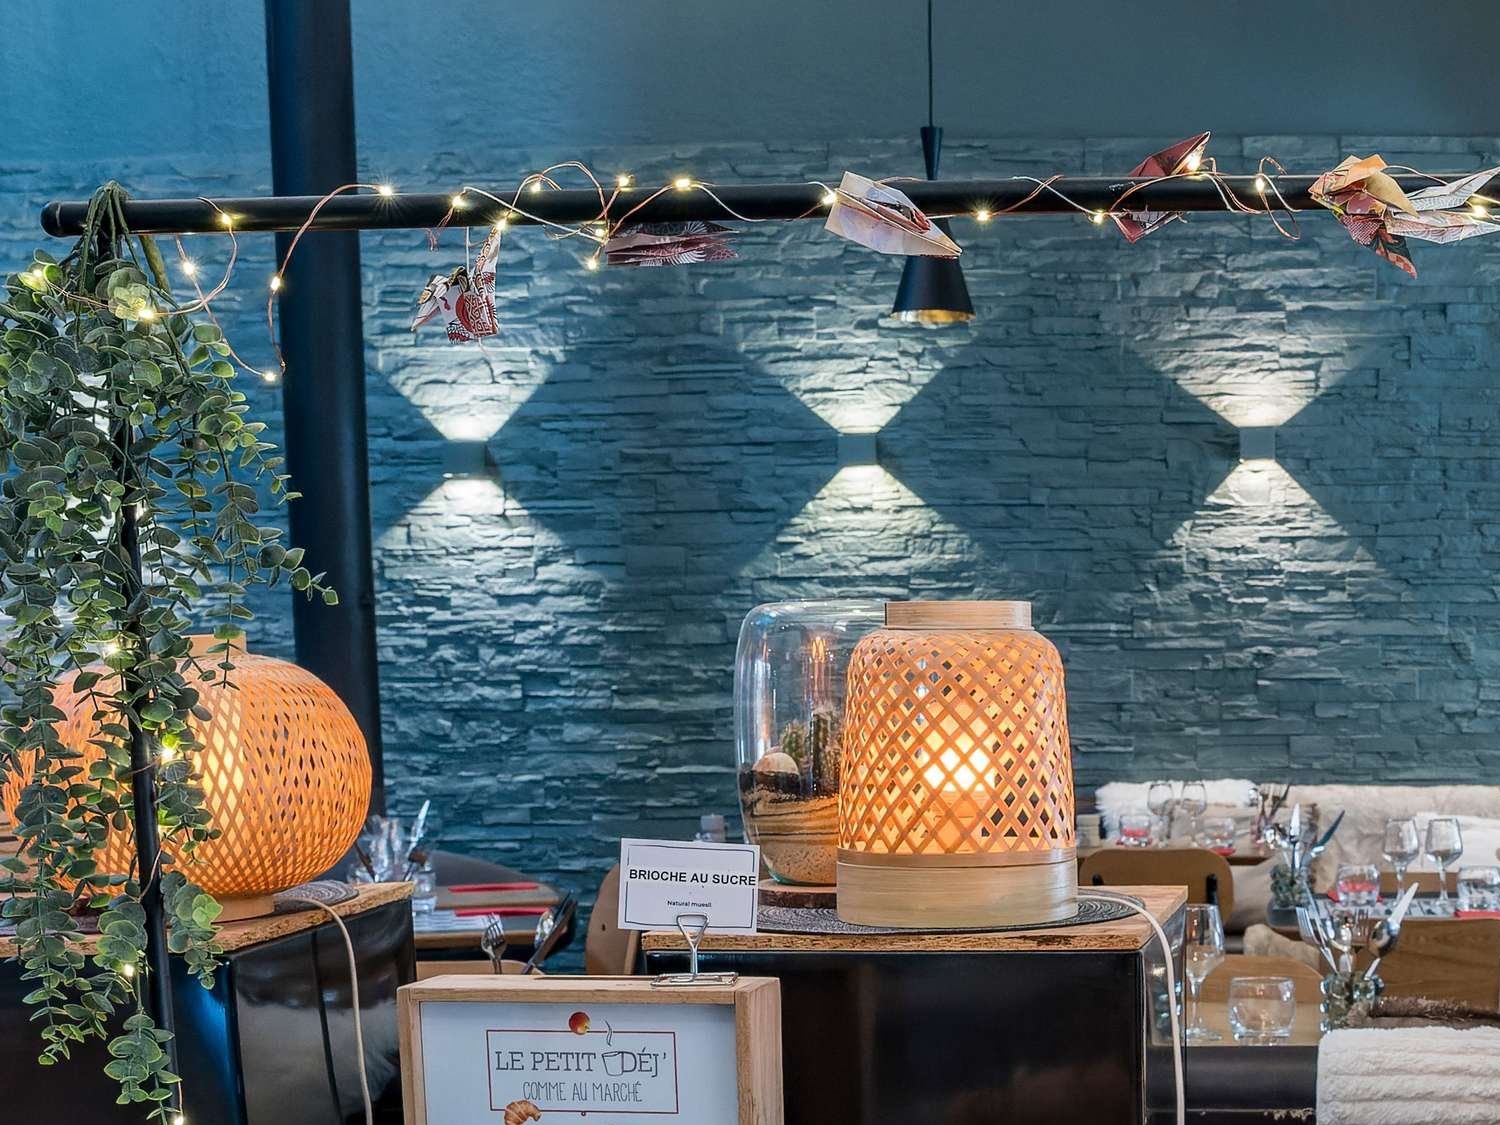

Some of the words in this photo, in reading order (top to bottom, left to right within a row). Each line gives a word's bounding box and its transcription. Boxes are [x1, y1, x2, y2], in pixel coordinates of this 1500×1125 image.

[629, 869, 687, 883] BRIOCHE
[690, 873, 708, 884] AU
[712, 875, 756, 886] SUCRE
[667, 900, 690, 908] Natural
[495, 1051, 524, 1071] LE
[531, 1051, 597, 1072] PETIT
[523, 1081, 566, 1101] COMME
[572, 1082, 588, 1101] AU
[592, 1081, 643, 1102] MARCHÉ
